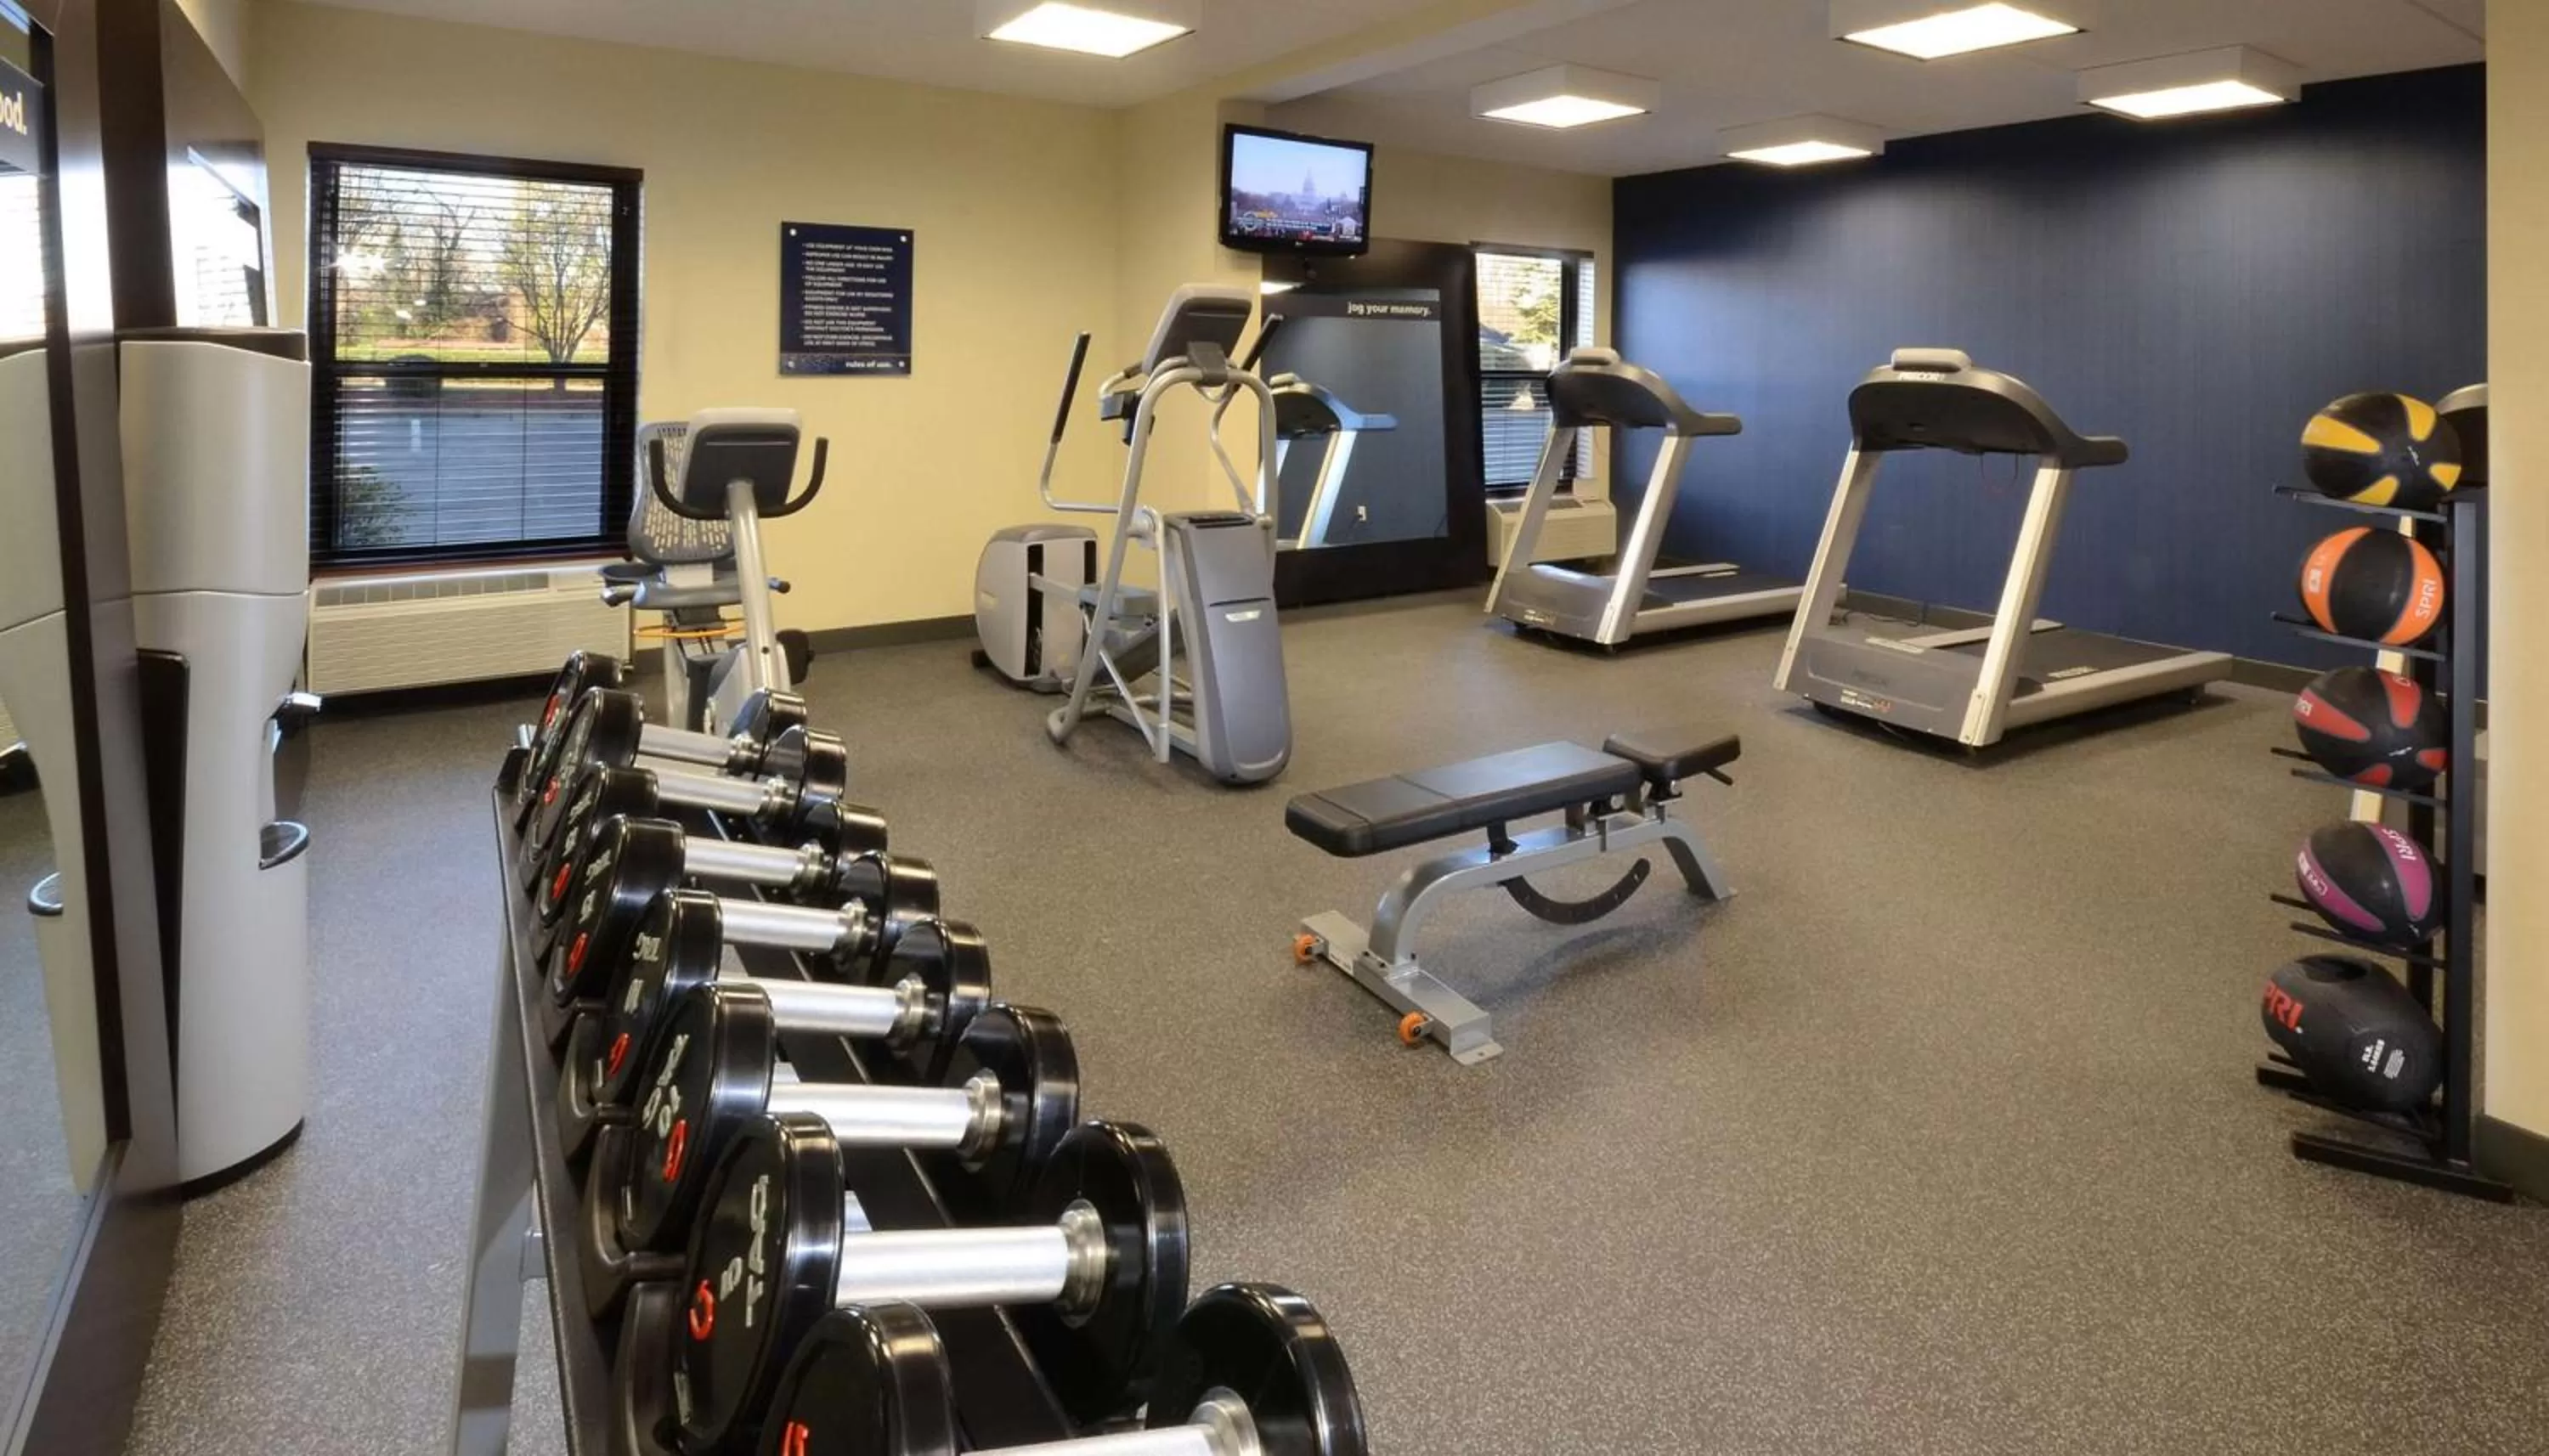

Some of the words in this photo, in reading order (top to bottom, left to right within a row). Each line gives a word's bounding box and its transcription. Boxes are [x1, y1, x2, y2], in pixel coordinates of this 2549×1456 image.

[1348, 302, 1365, 315] jog
[1365, 305, 1388, 315] your
[867, 359, 875, 368] of
[2415, 578, 2437, 619] SPRI
[2382, 828, 2417, 861] SPRI
[2264, 979, 2304, 1032] PRI
